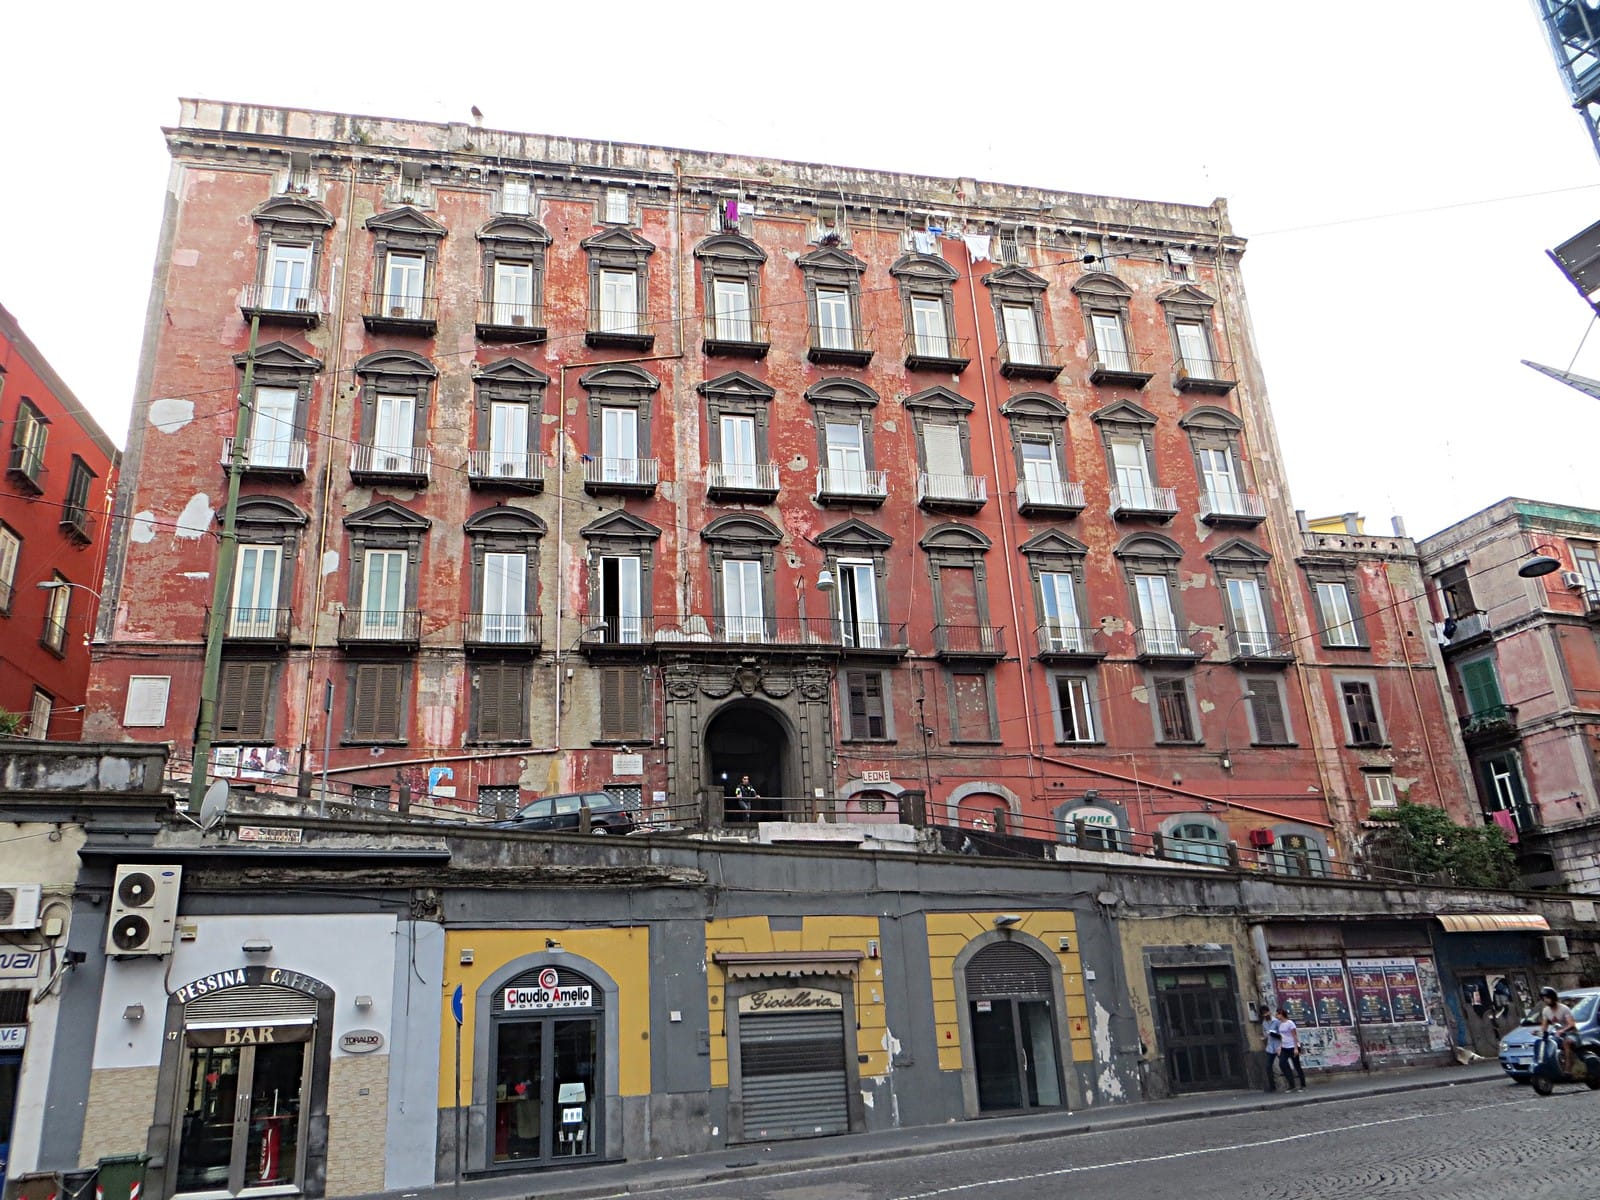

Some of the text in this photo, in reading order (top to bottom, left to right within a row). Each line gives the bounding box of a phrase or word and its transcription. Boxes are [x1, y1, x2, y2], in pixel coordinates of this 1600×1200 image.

[863, 771, 889, 781] LEONE
[176, 968, 246, 1003] PESSINA
[507, 986, 590, 1004] Claudio Amelio
[750, 991, 840, 1010] Gioielleria
[223, 1026, 275, 1044] BAR
